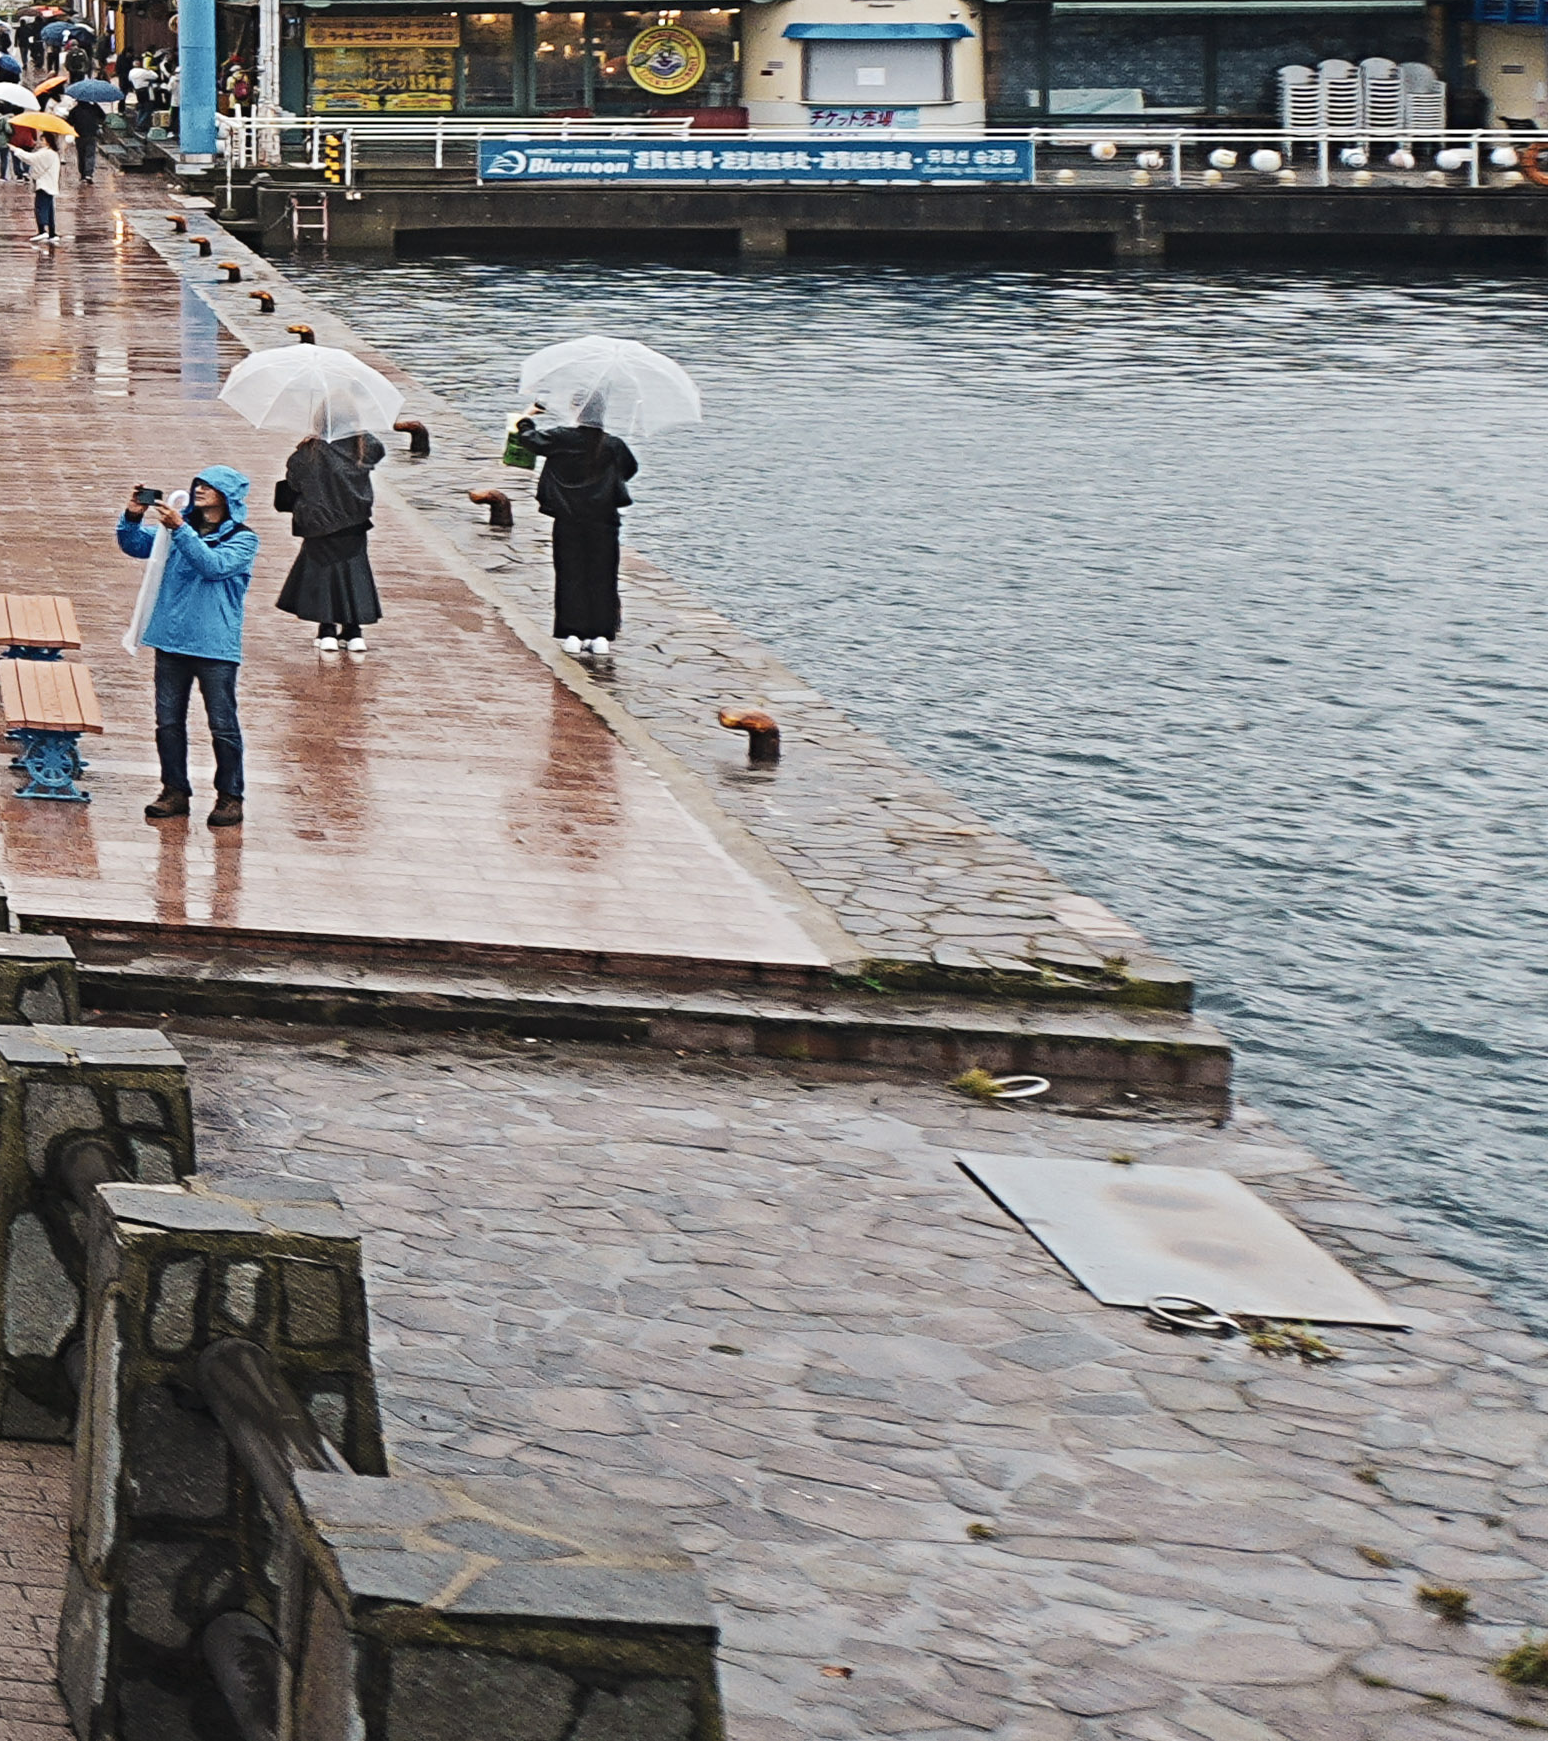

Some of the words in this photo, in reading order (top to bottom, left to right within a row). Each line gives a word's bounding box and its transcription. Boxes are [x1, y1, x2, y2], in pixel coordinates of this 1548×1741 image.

[810, 110, 894, 127] チケット売場
[527, 157, 630, 174] Bluemoon
